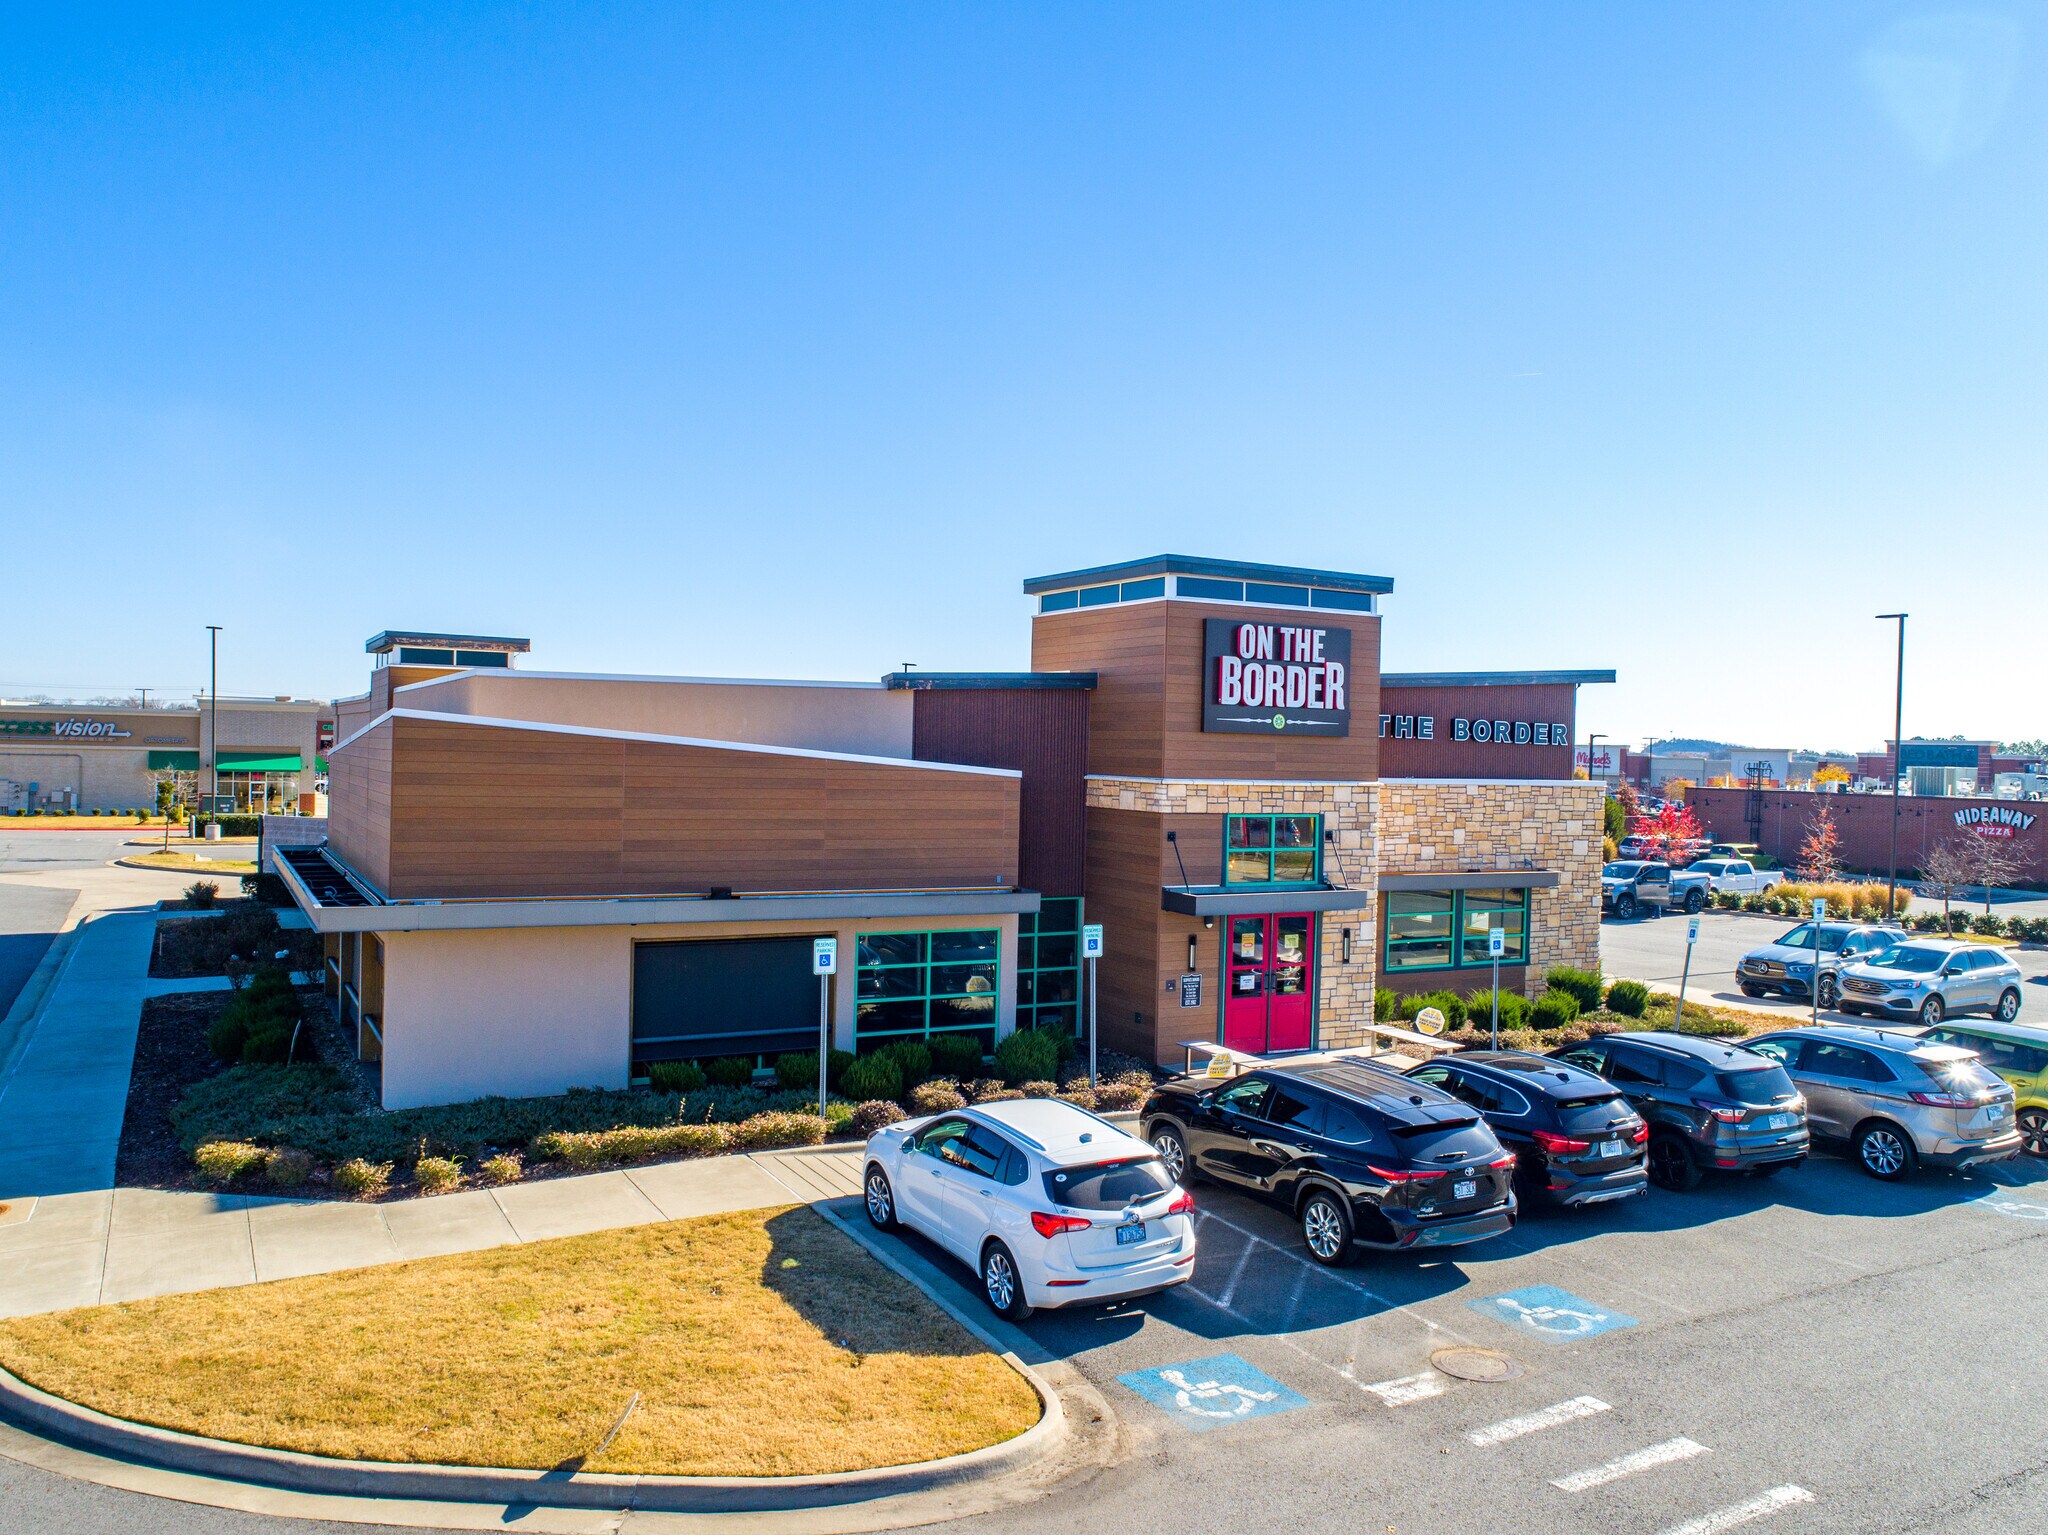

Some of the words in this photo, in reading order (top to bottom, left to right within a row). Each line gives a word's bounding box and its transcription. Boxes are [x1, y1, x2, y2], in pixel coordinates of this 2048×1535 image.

[1237, 624, 1274, 660] ON
[1279, 627, 1326, 663] THE
[1219, 656, 1345, 710] BORDER
[55, 718, 117, 736] vision
[1379, 714, 1434, 740] THE
[1453, 718, 1568, 746] BORDER
[1953, 806, 2034, 830] HIDEAWAY
[1976, 826, 2011, 836] PIZZA
